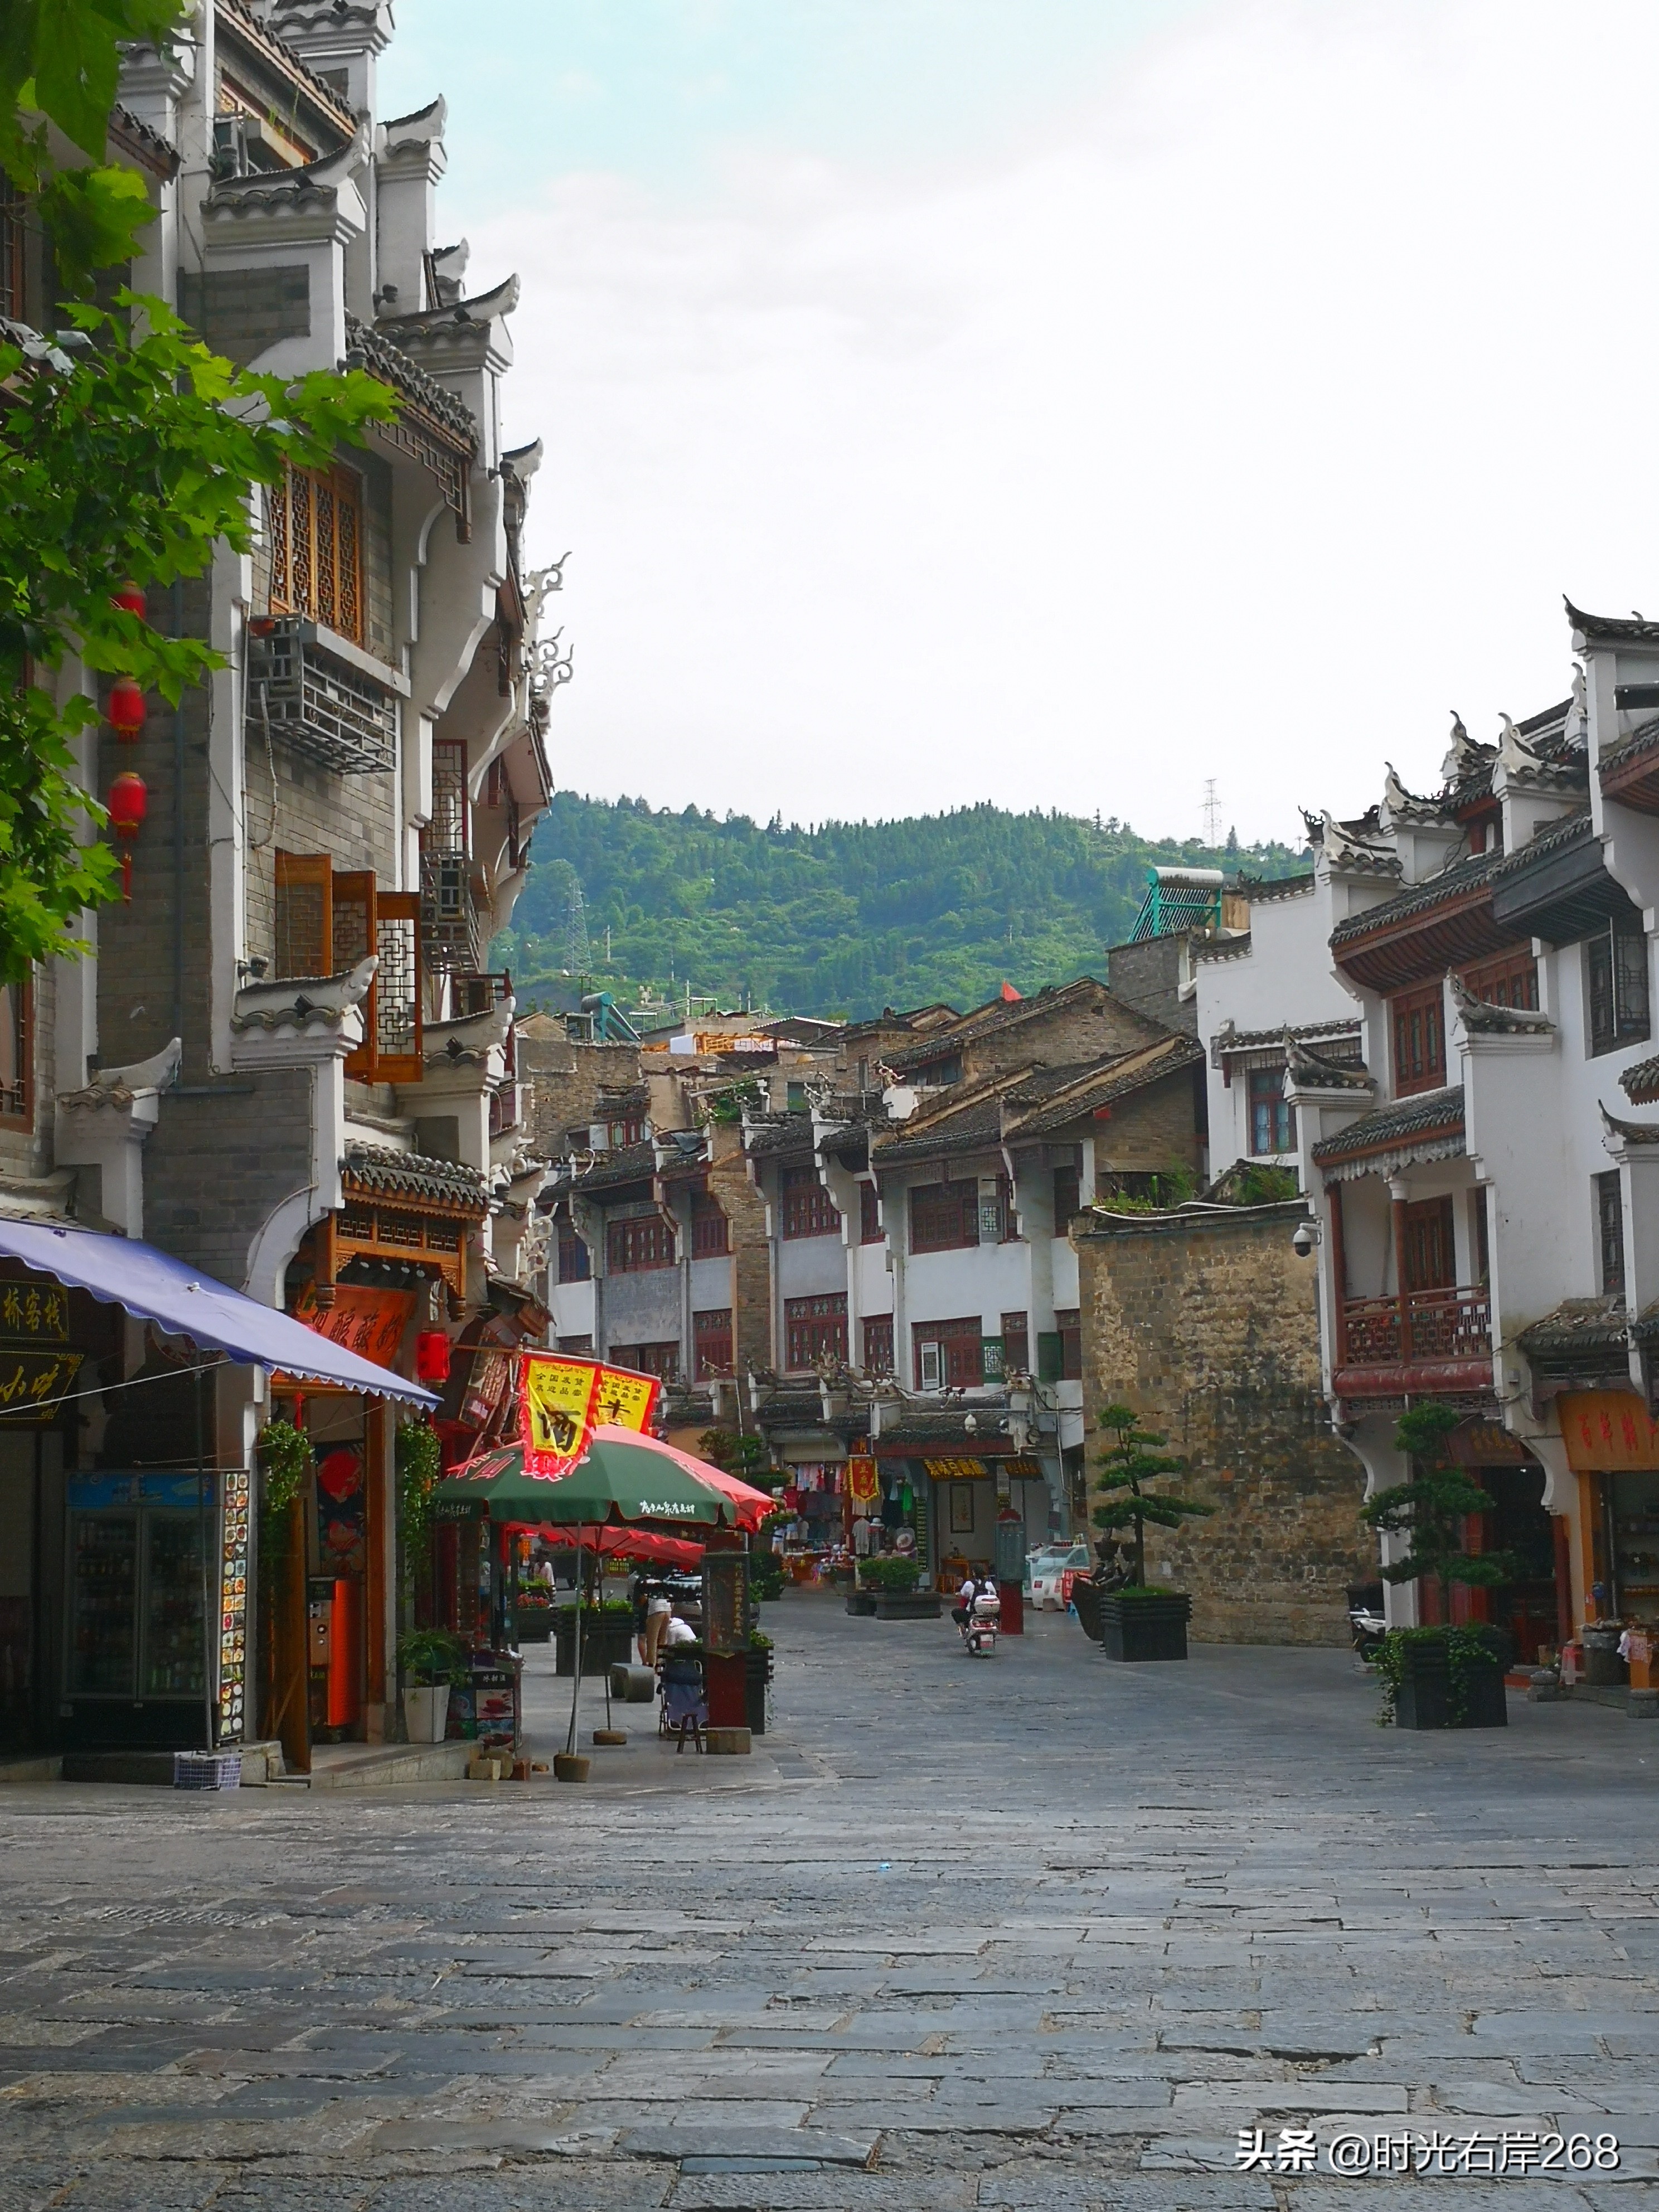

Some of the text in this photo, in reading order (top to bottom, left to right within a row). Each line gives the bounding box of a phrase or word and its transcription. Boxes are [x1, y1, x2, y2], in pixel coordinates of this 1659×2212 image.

[4, 1288, 63, 1331] 桥客栈
[535, 1384, 583, 1397] 欢迎品尝
[536, 1372, 585, 1386] 全国发货
[537, 1402, 581, 1453] 酒
